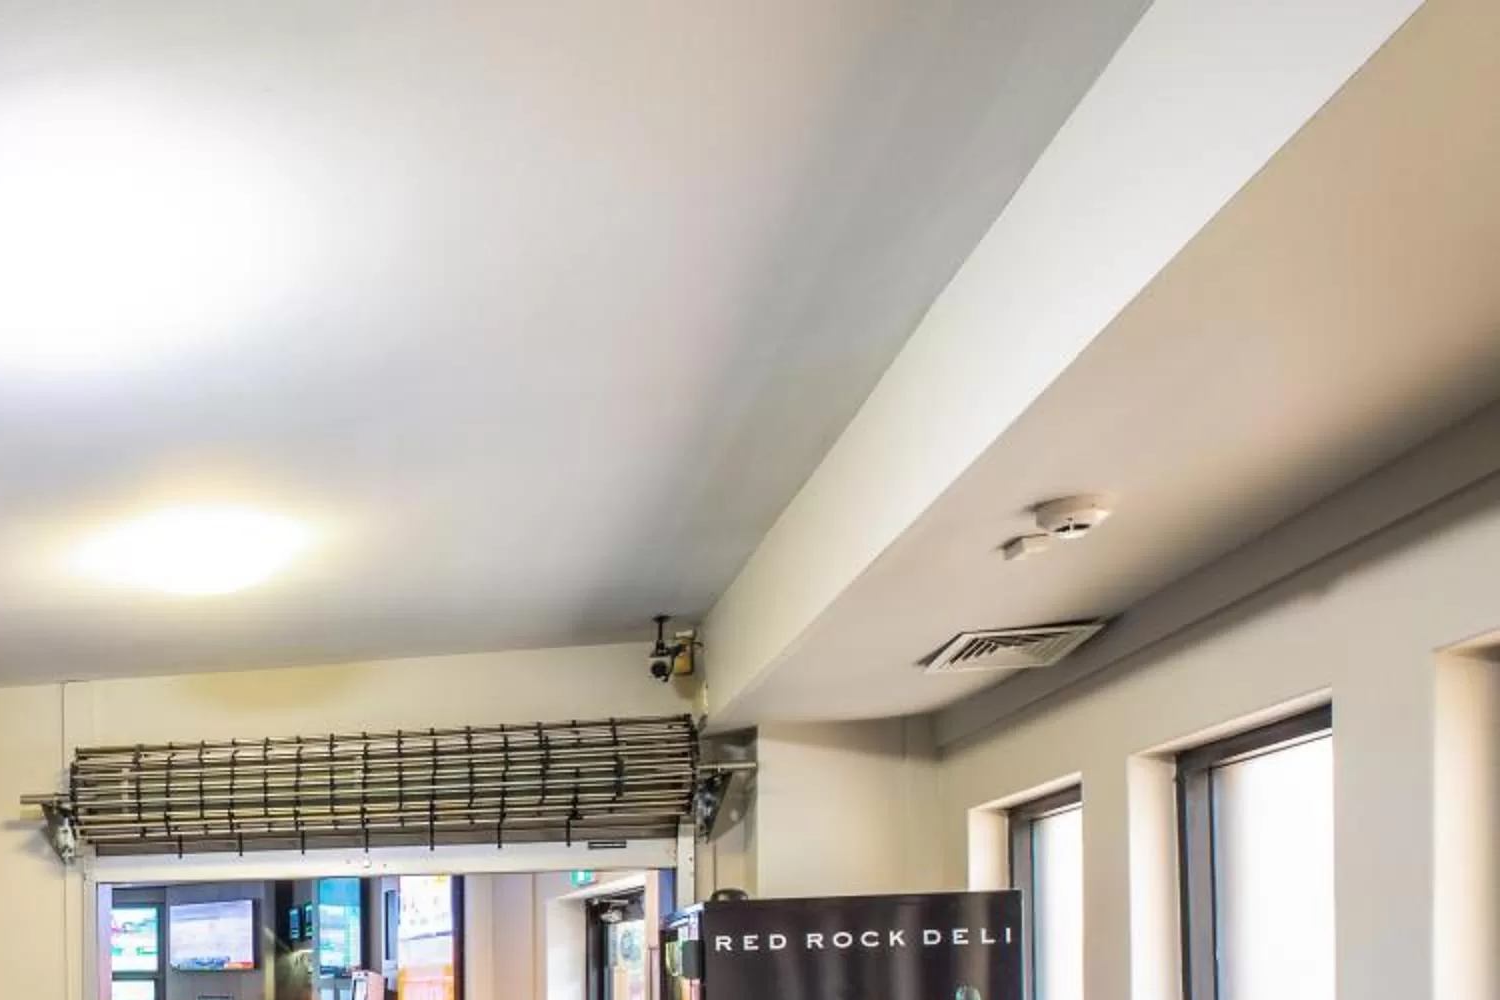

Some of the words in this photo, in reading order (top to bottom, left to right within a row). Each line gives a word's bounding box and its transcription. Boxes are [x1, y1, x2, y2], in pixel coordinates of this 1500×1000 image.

[715, 933, 789, 952] RED
[806, 930, 906, 950] ROCK
[923, 927, 1013, 946] DELI
